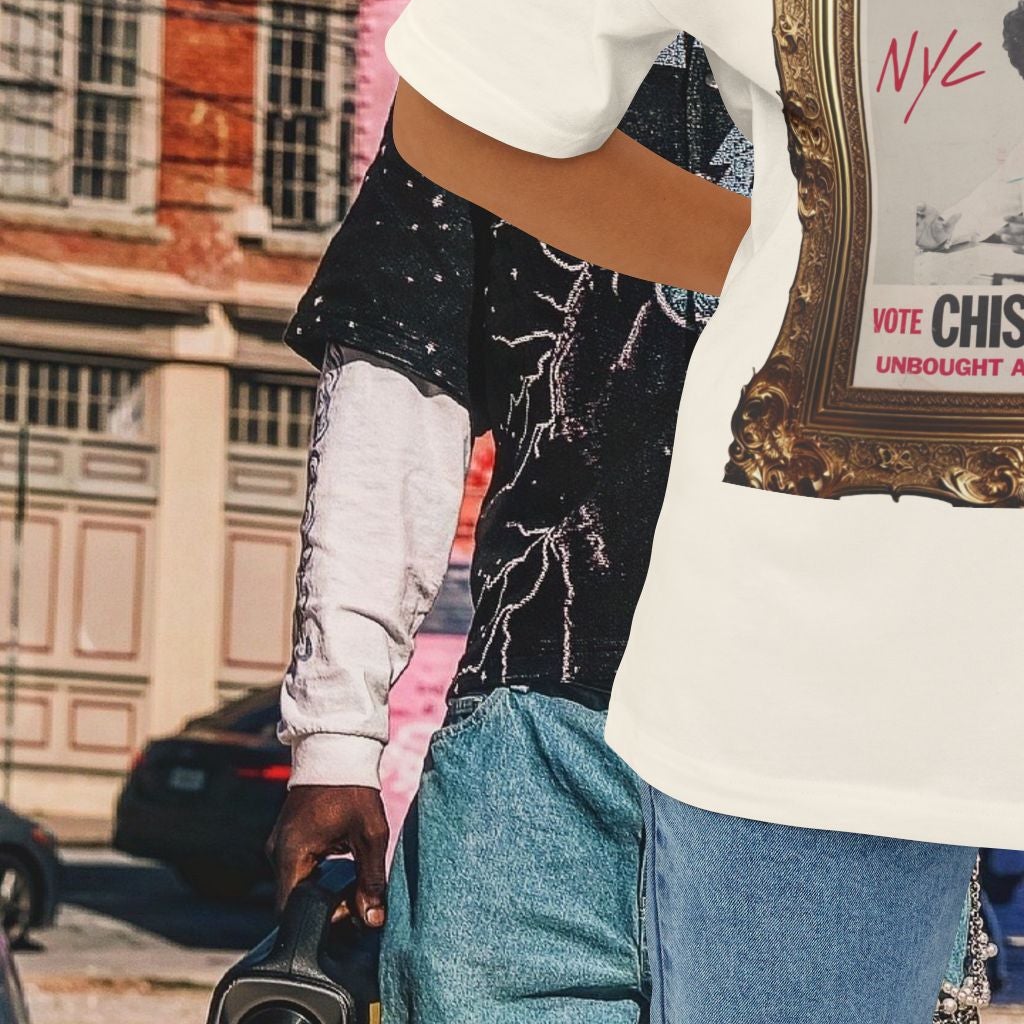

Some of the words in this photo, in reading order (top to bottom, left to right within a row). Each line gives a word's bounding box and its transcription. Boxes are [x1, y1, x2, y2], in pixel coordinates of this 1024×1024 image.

[876, 29, 985, 123] NYC
[873, 308, 923, 335] VOTE
[876, 356, 1004, 377] UNBOUGHT
